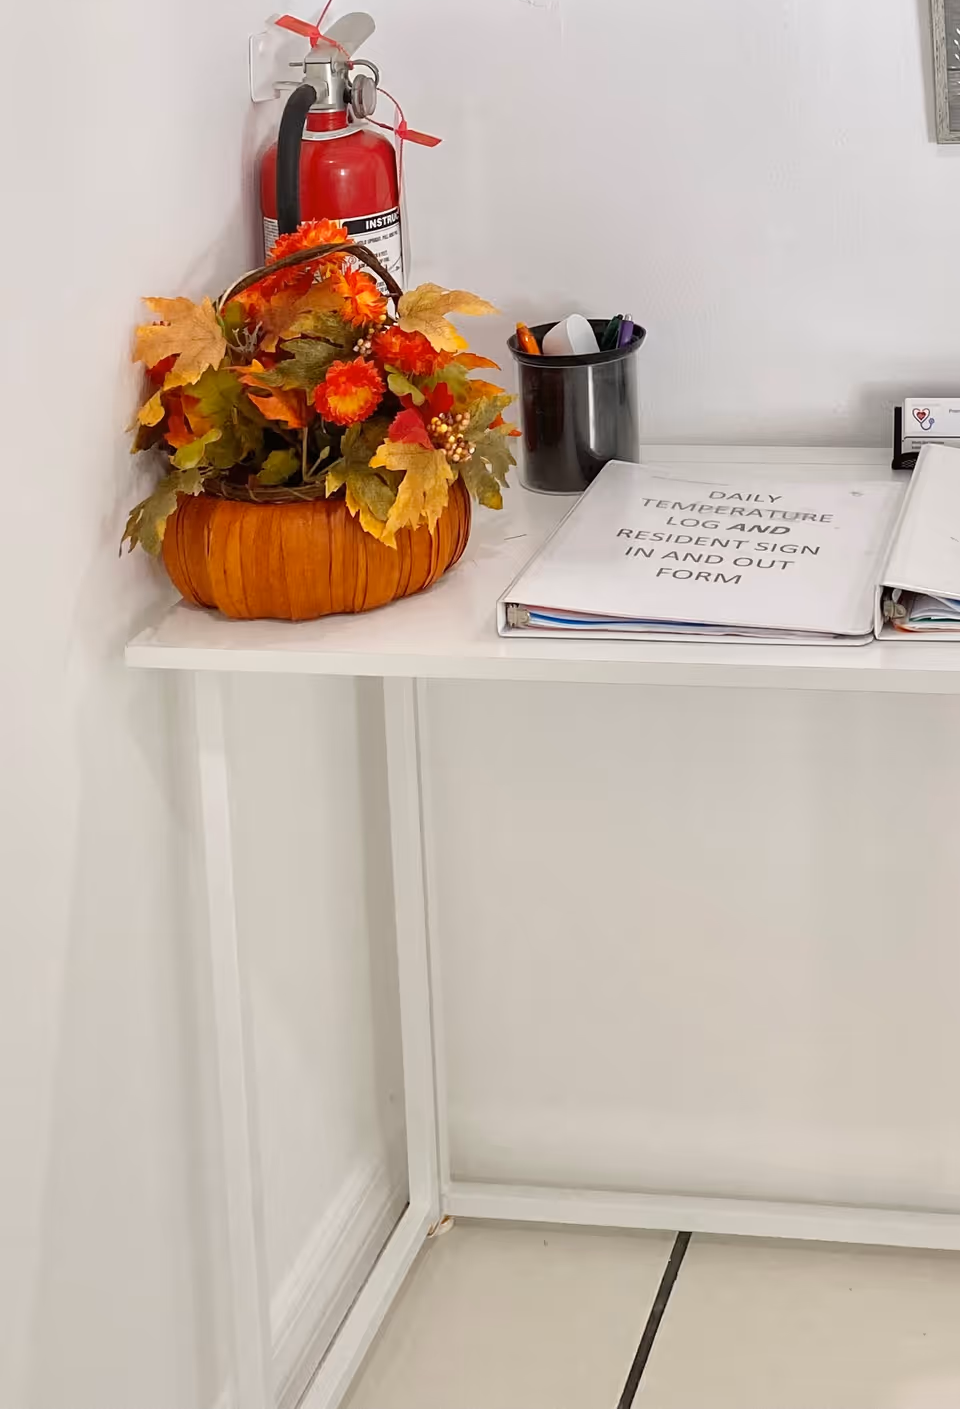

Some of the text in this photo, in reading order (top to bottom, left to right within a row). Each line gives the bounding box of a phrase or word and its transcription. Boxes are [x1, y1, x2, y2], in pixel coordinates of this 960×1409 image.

[708, 490, 782, 503] DAILY
[641, 497, 834, 523] TEMPERATURE
[666, 516, 791, 535] LOG AND
[616, 528, 821, 556] RESIDENT SIGN
[624, 546, 796, 571] IN AND OUT
[655, 567, 743, 585] FORM
